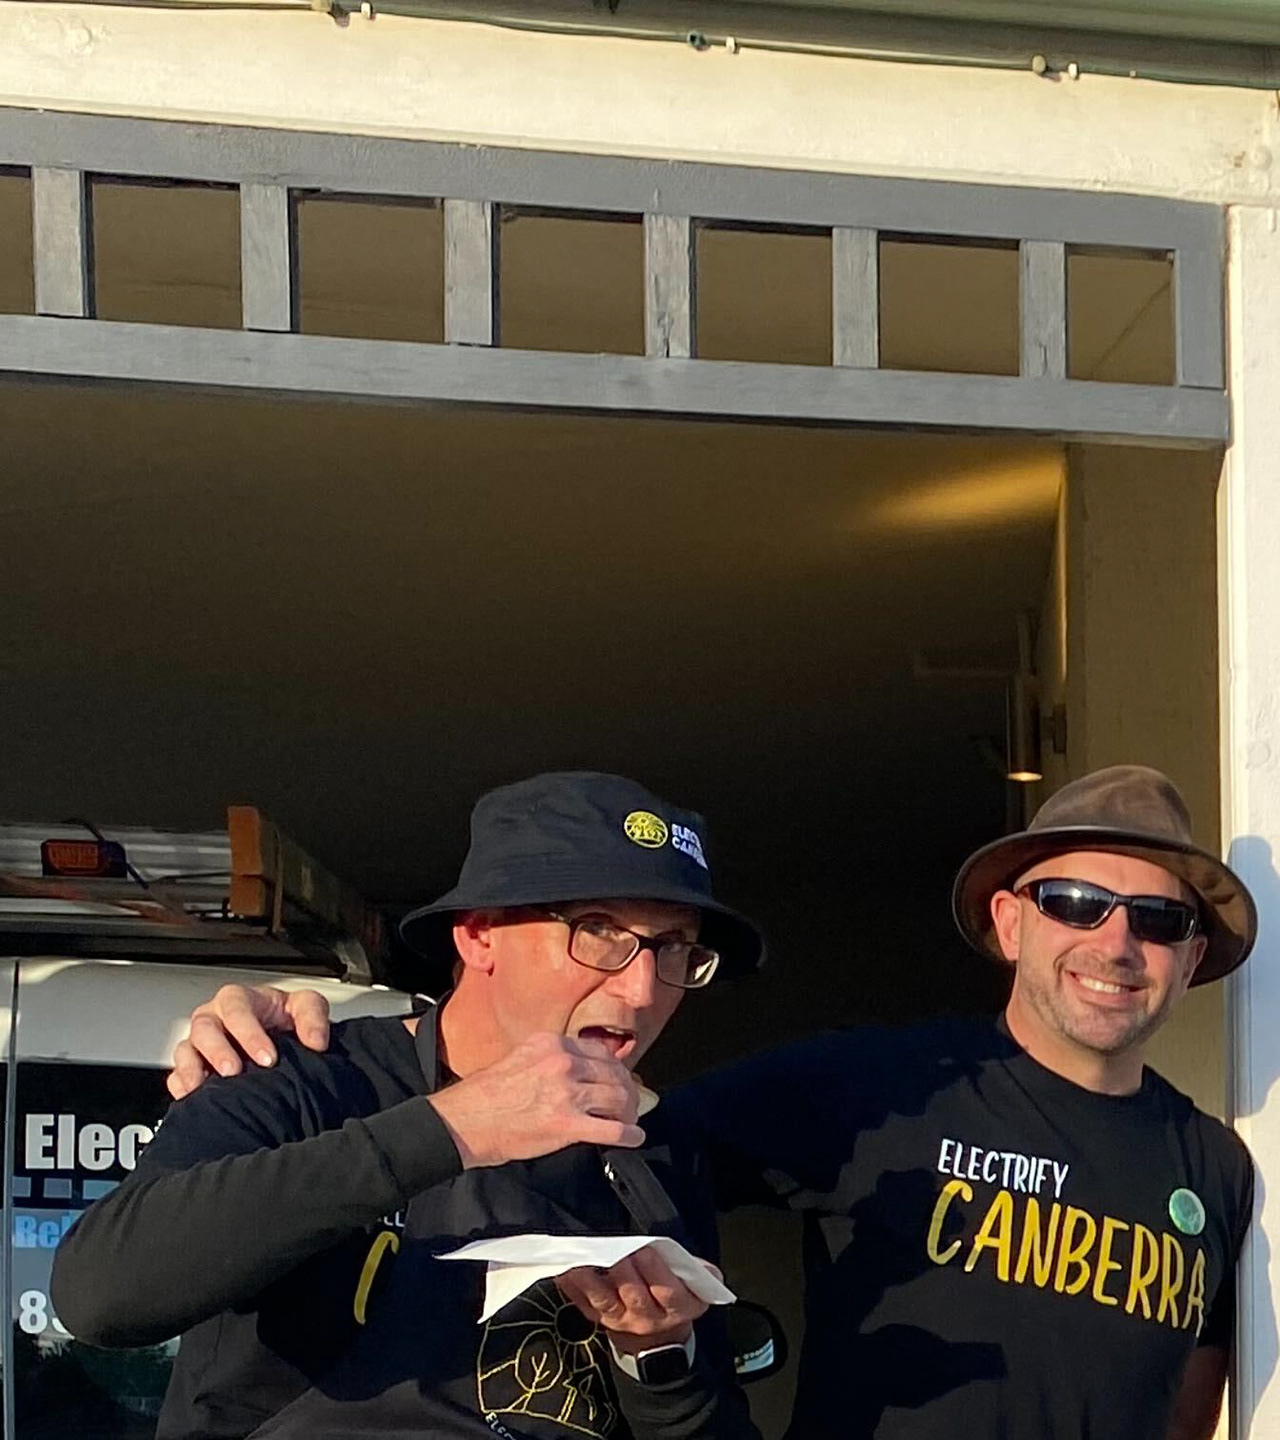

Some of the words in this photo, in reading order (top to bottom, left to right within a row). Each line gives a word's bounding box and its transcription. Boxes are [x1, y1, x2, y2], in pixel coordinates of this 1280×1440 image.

[25, 1113, 163, 1171] Elec
[938, 1138, 1069, 1198] ELECTRIFY
[927, 1180, 1206, 1338] CANBERRA
